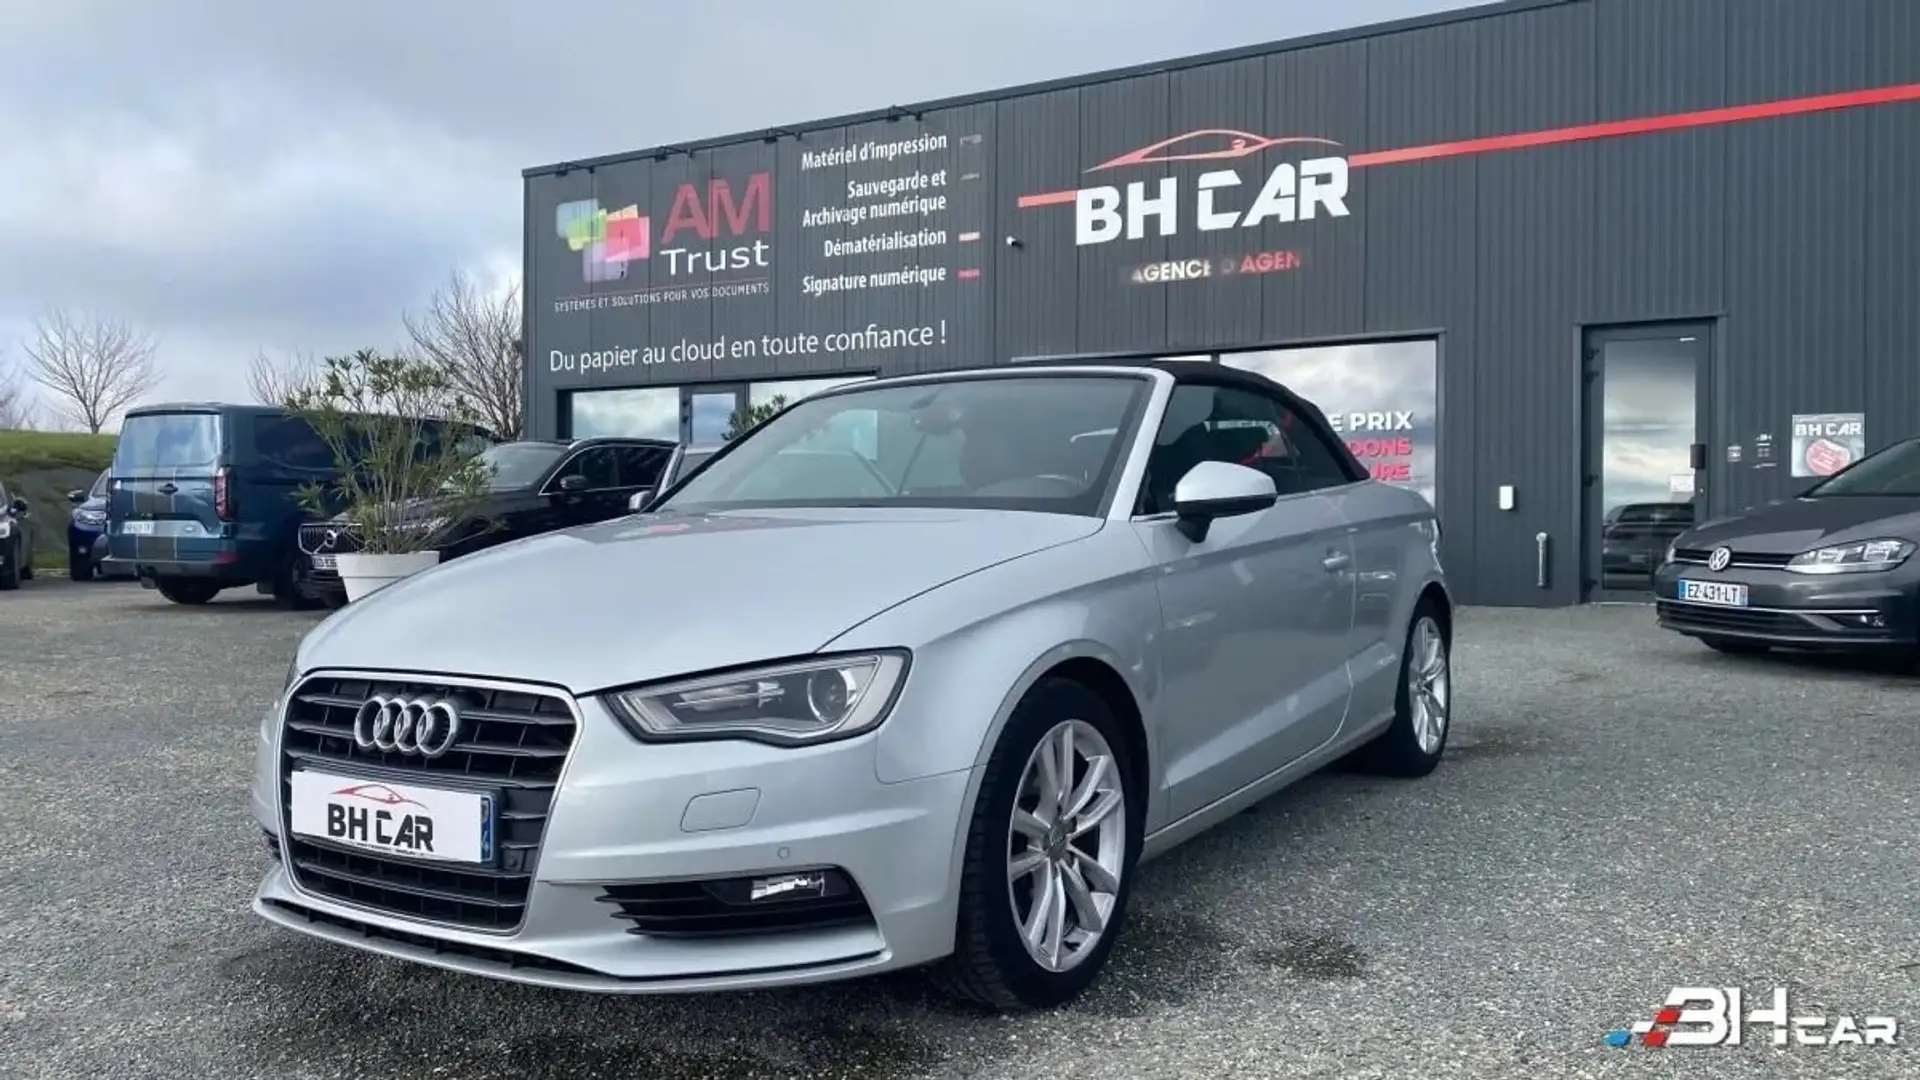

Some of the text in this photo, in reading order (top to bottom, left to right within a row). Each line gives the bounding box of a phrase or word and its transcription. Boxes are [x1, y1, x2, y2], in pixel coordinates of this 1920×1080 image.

[802, 133, 948, 171] Matériel d'impression
[848, 169, 947, 198] Sauvegarde et
[661, 171, 770, 244] AM
[803, 195, 947, 228] Archivage numérique
[1076, 157, 1351, 246] BH CAR
[660, 240, 770, 276] Trust
[824, 228, 947, 258] Dématérialisation
[599, 297, 609, 309] ET
[612, 291, 661, 308] SOLUTIONS
[664, 290, 687, 302] POUR
[691, 287, 709, 299] VOS
[712, 282, 770, 298] DOCUMENTS
[802, 265, 947, 297] Signature numérique
[550, 350, 575, 372] Du
[580, 346, 639, 375] papier
[642, 347, 666, 363] au
[670, 335, 725, 362] cloud
[731, 339, 756, 358] en
[762, 332, 819, 356] toute
[824, 323, 934, 352] confiance
[1350, 410, 1413, 431] PRIX
[1795, 422, 1863, 436] BH CAR
[1347, 437, 1411, 456] DONS
[328, 803, 434, 852] BH CAR
